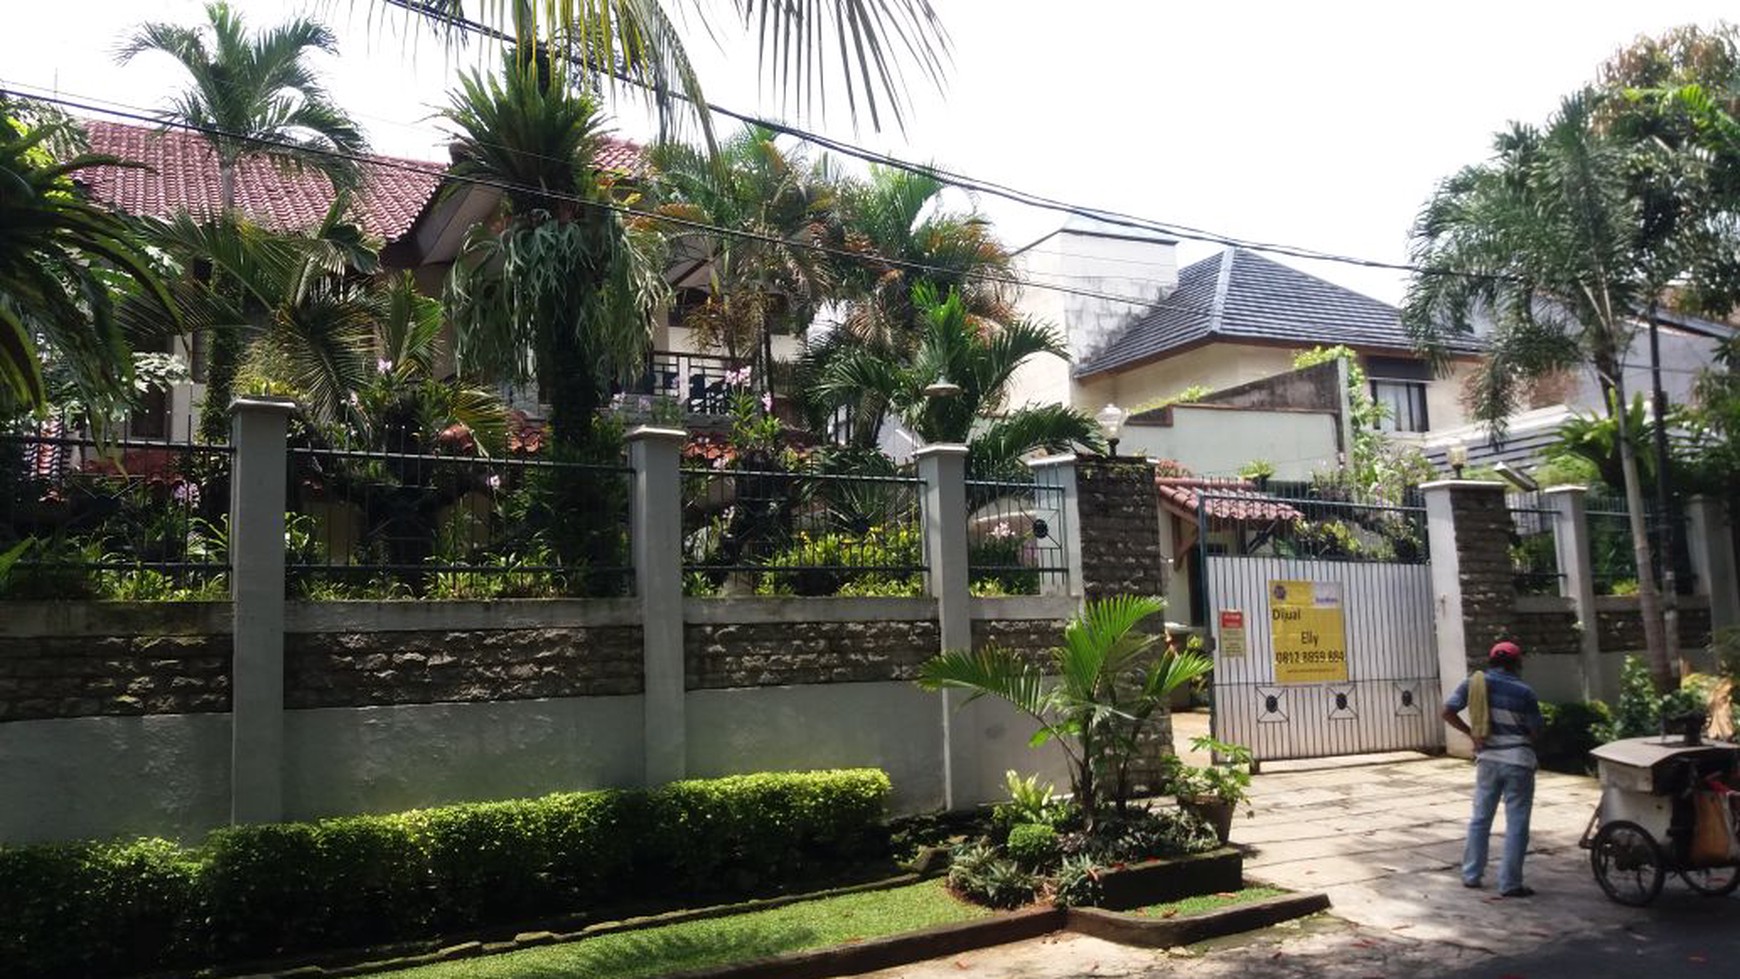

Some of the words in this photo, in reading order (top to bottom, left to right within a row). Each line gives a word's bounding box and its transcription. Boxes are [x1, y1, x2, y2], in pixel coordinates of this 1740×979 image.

[1272, 609, 1301, 622] Dijual
[1301, 631, 1319, 646] Elly
[1275, 651, 1300, 664] 0812
